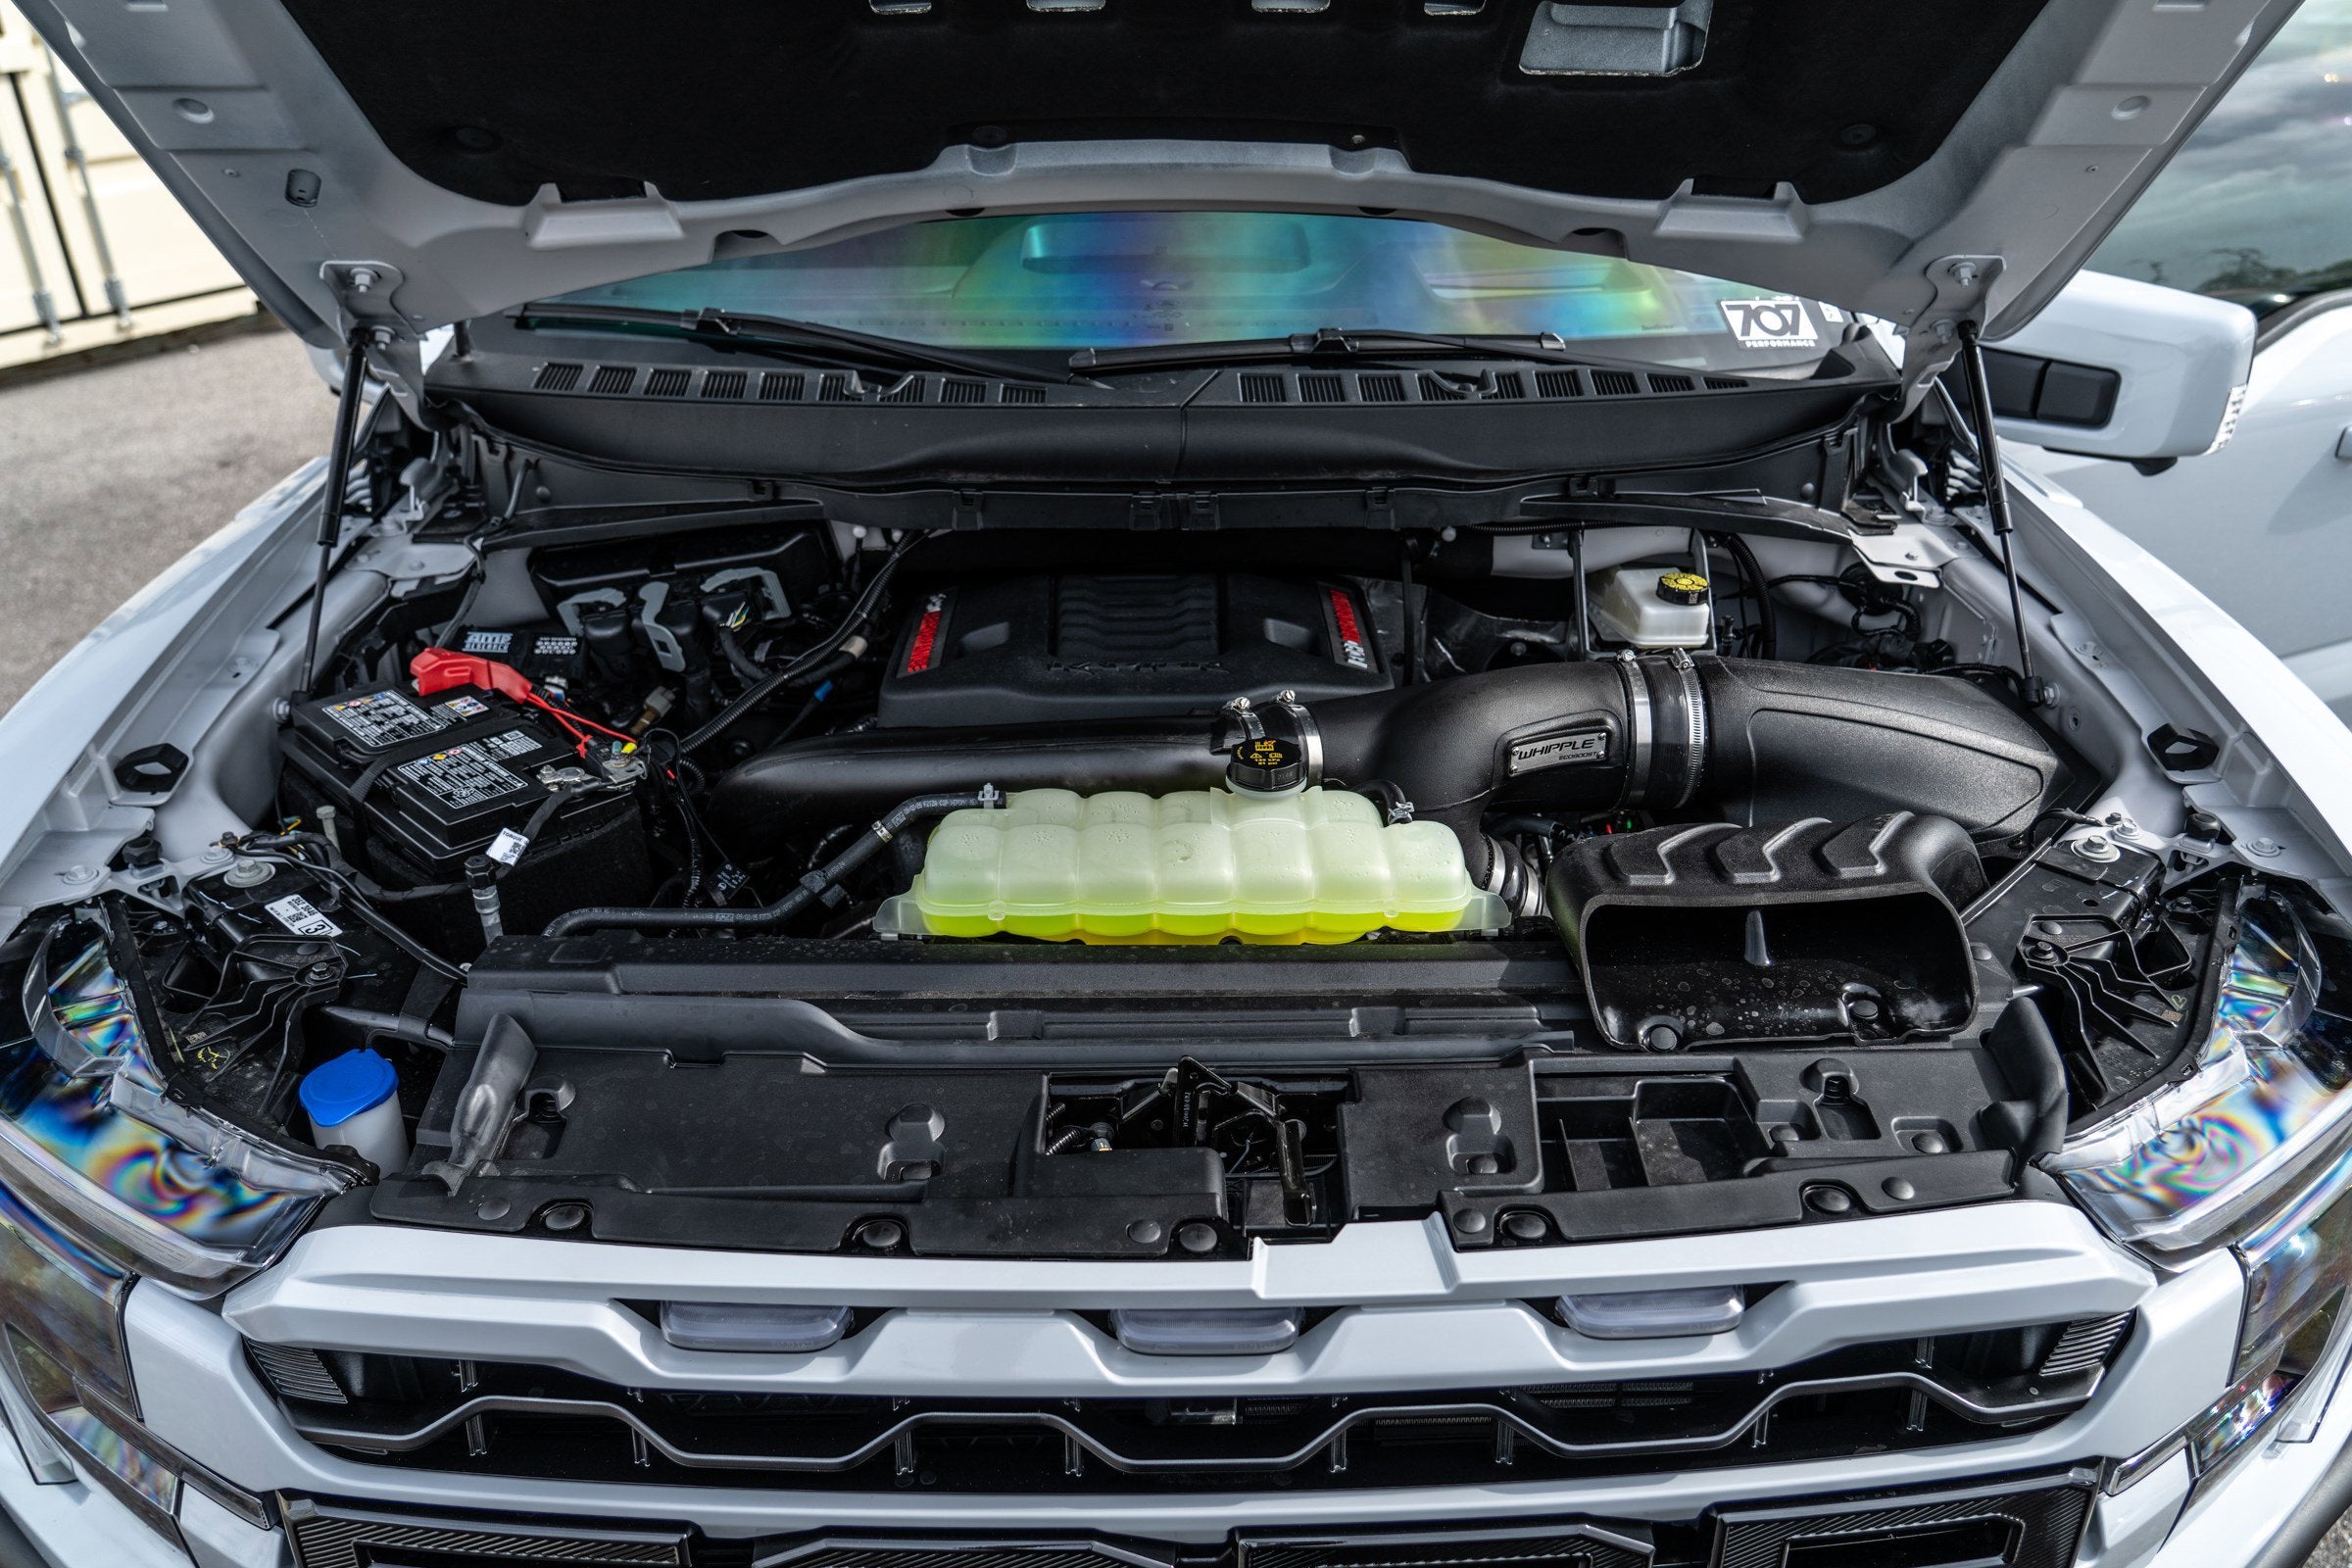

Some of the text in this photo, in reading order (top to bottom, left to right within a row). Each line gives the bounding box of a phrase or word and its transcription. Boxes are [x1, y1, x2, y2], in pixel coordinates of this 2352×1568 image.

[1725, 304, 1801, 337] 707
[1744, 339, 1816, 348] PERFORMANCE
[1517, 738, 1595, 760] WHIPPLE
[1558, 751, 1598, 760] ECOBOOST
